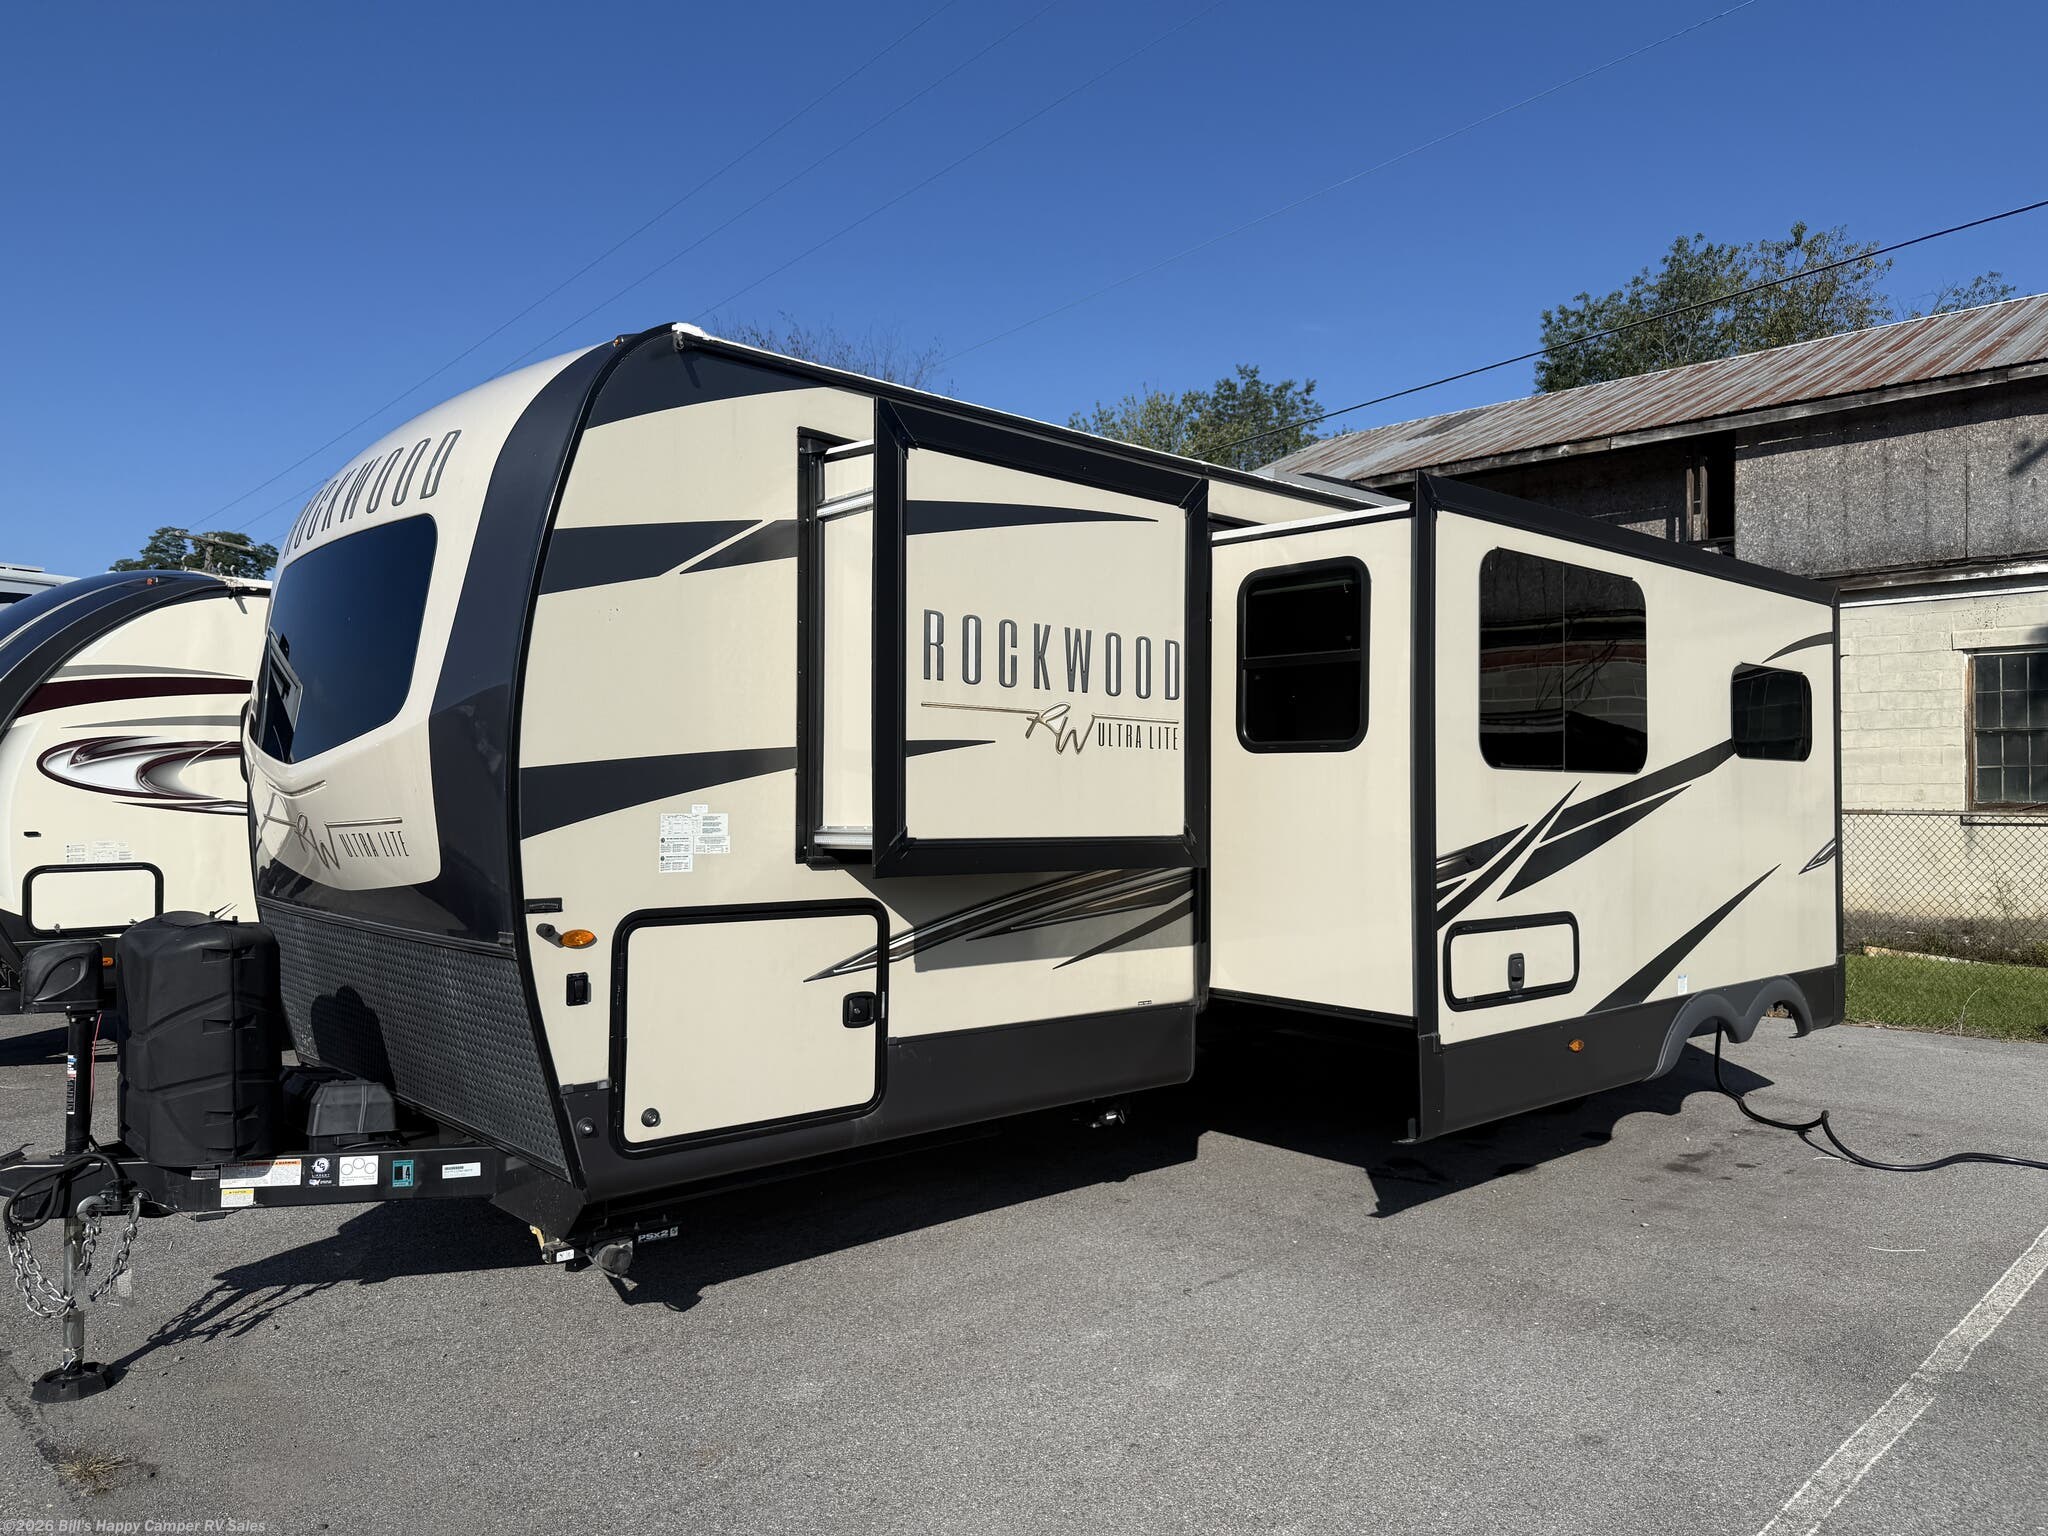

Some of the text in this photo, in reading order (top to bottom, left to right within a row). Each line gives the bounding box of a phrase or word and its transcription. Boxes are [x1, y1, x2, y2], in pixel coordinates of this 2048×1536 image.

[923, 608, 1181, 701] ROCKWOOD
[1098, 722, 1179, 751] ULTRA LITE
[338, 830, 410, 858] ULTRA LITE
